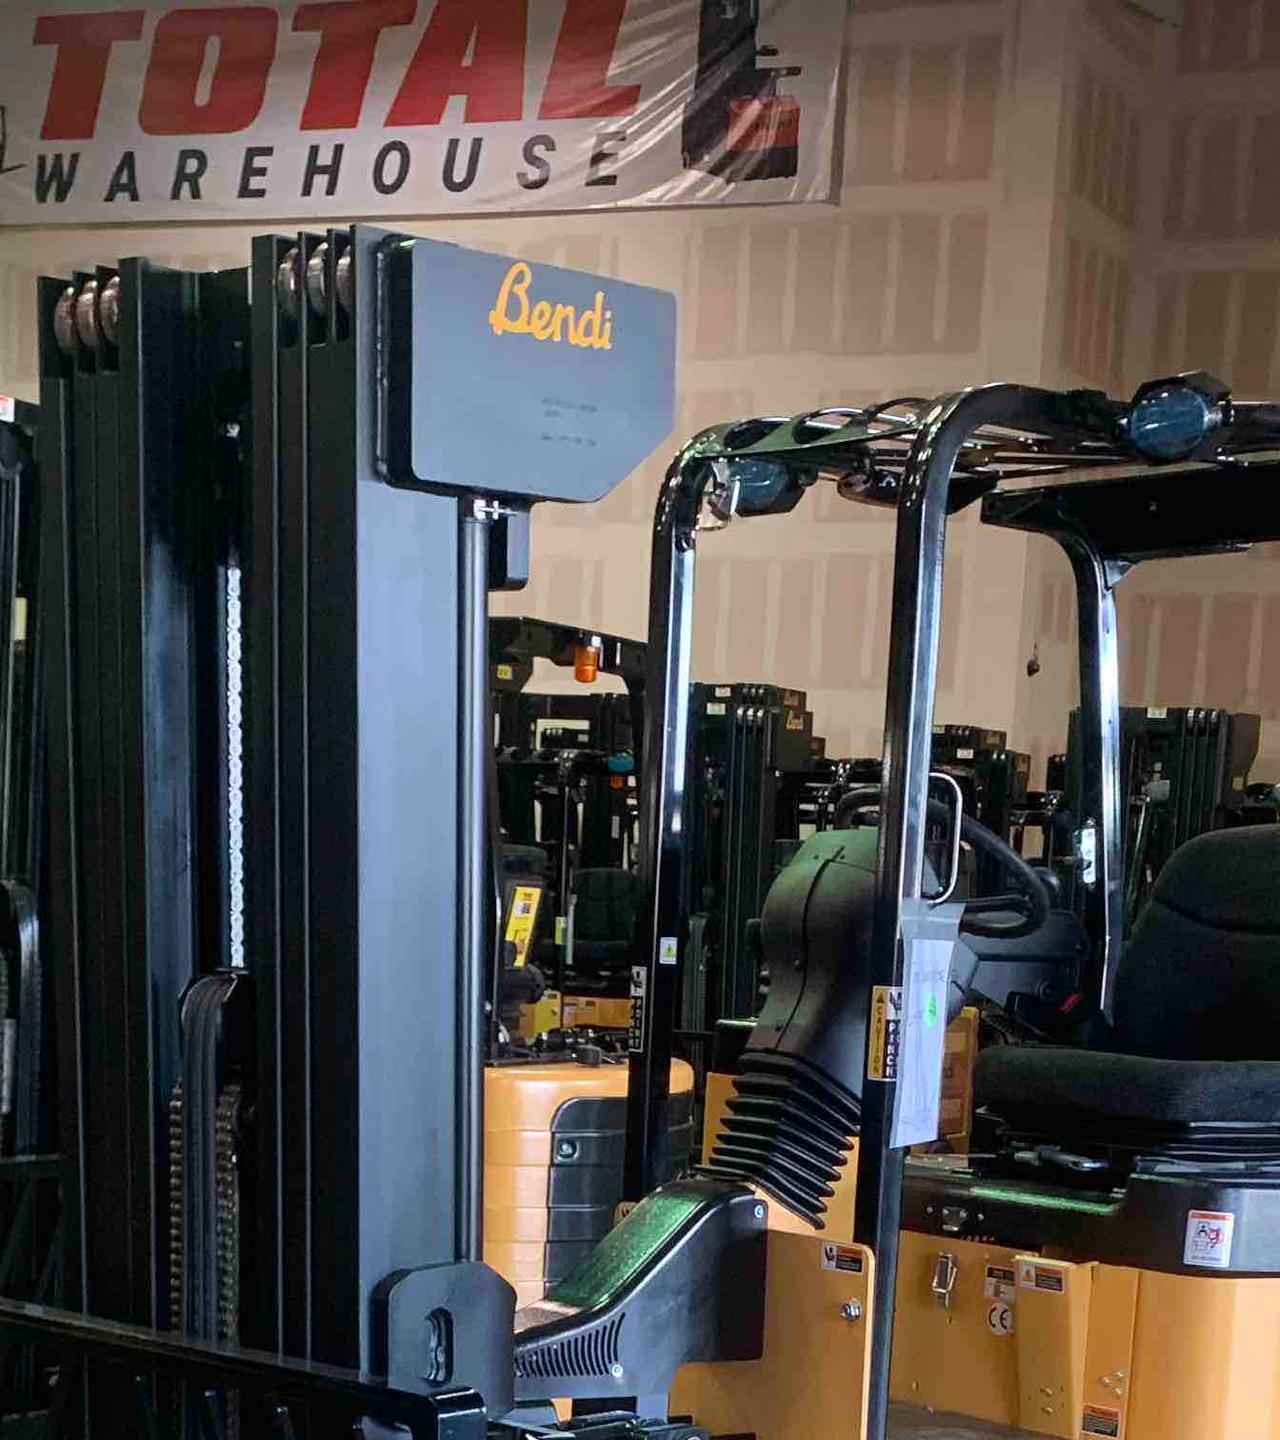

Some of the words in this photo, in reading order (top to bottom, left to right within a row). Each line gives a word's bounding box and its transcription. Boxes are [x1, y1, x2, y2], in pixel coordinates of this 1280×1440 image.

[33, 0, 642, 140] TOTAL
[34, 130, 628, 203] WAREHOUSE
[489, 261, 612, 349] Bendi
